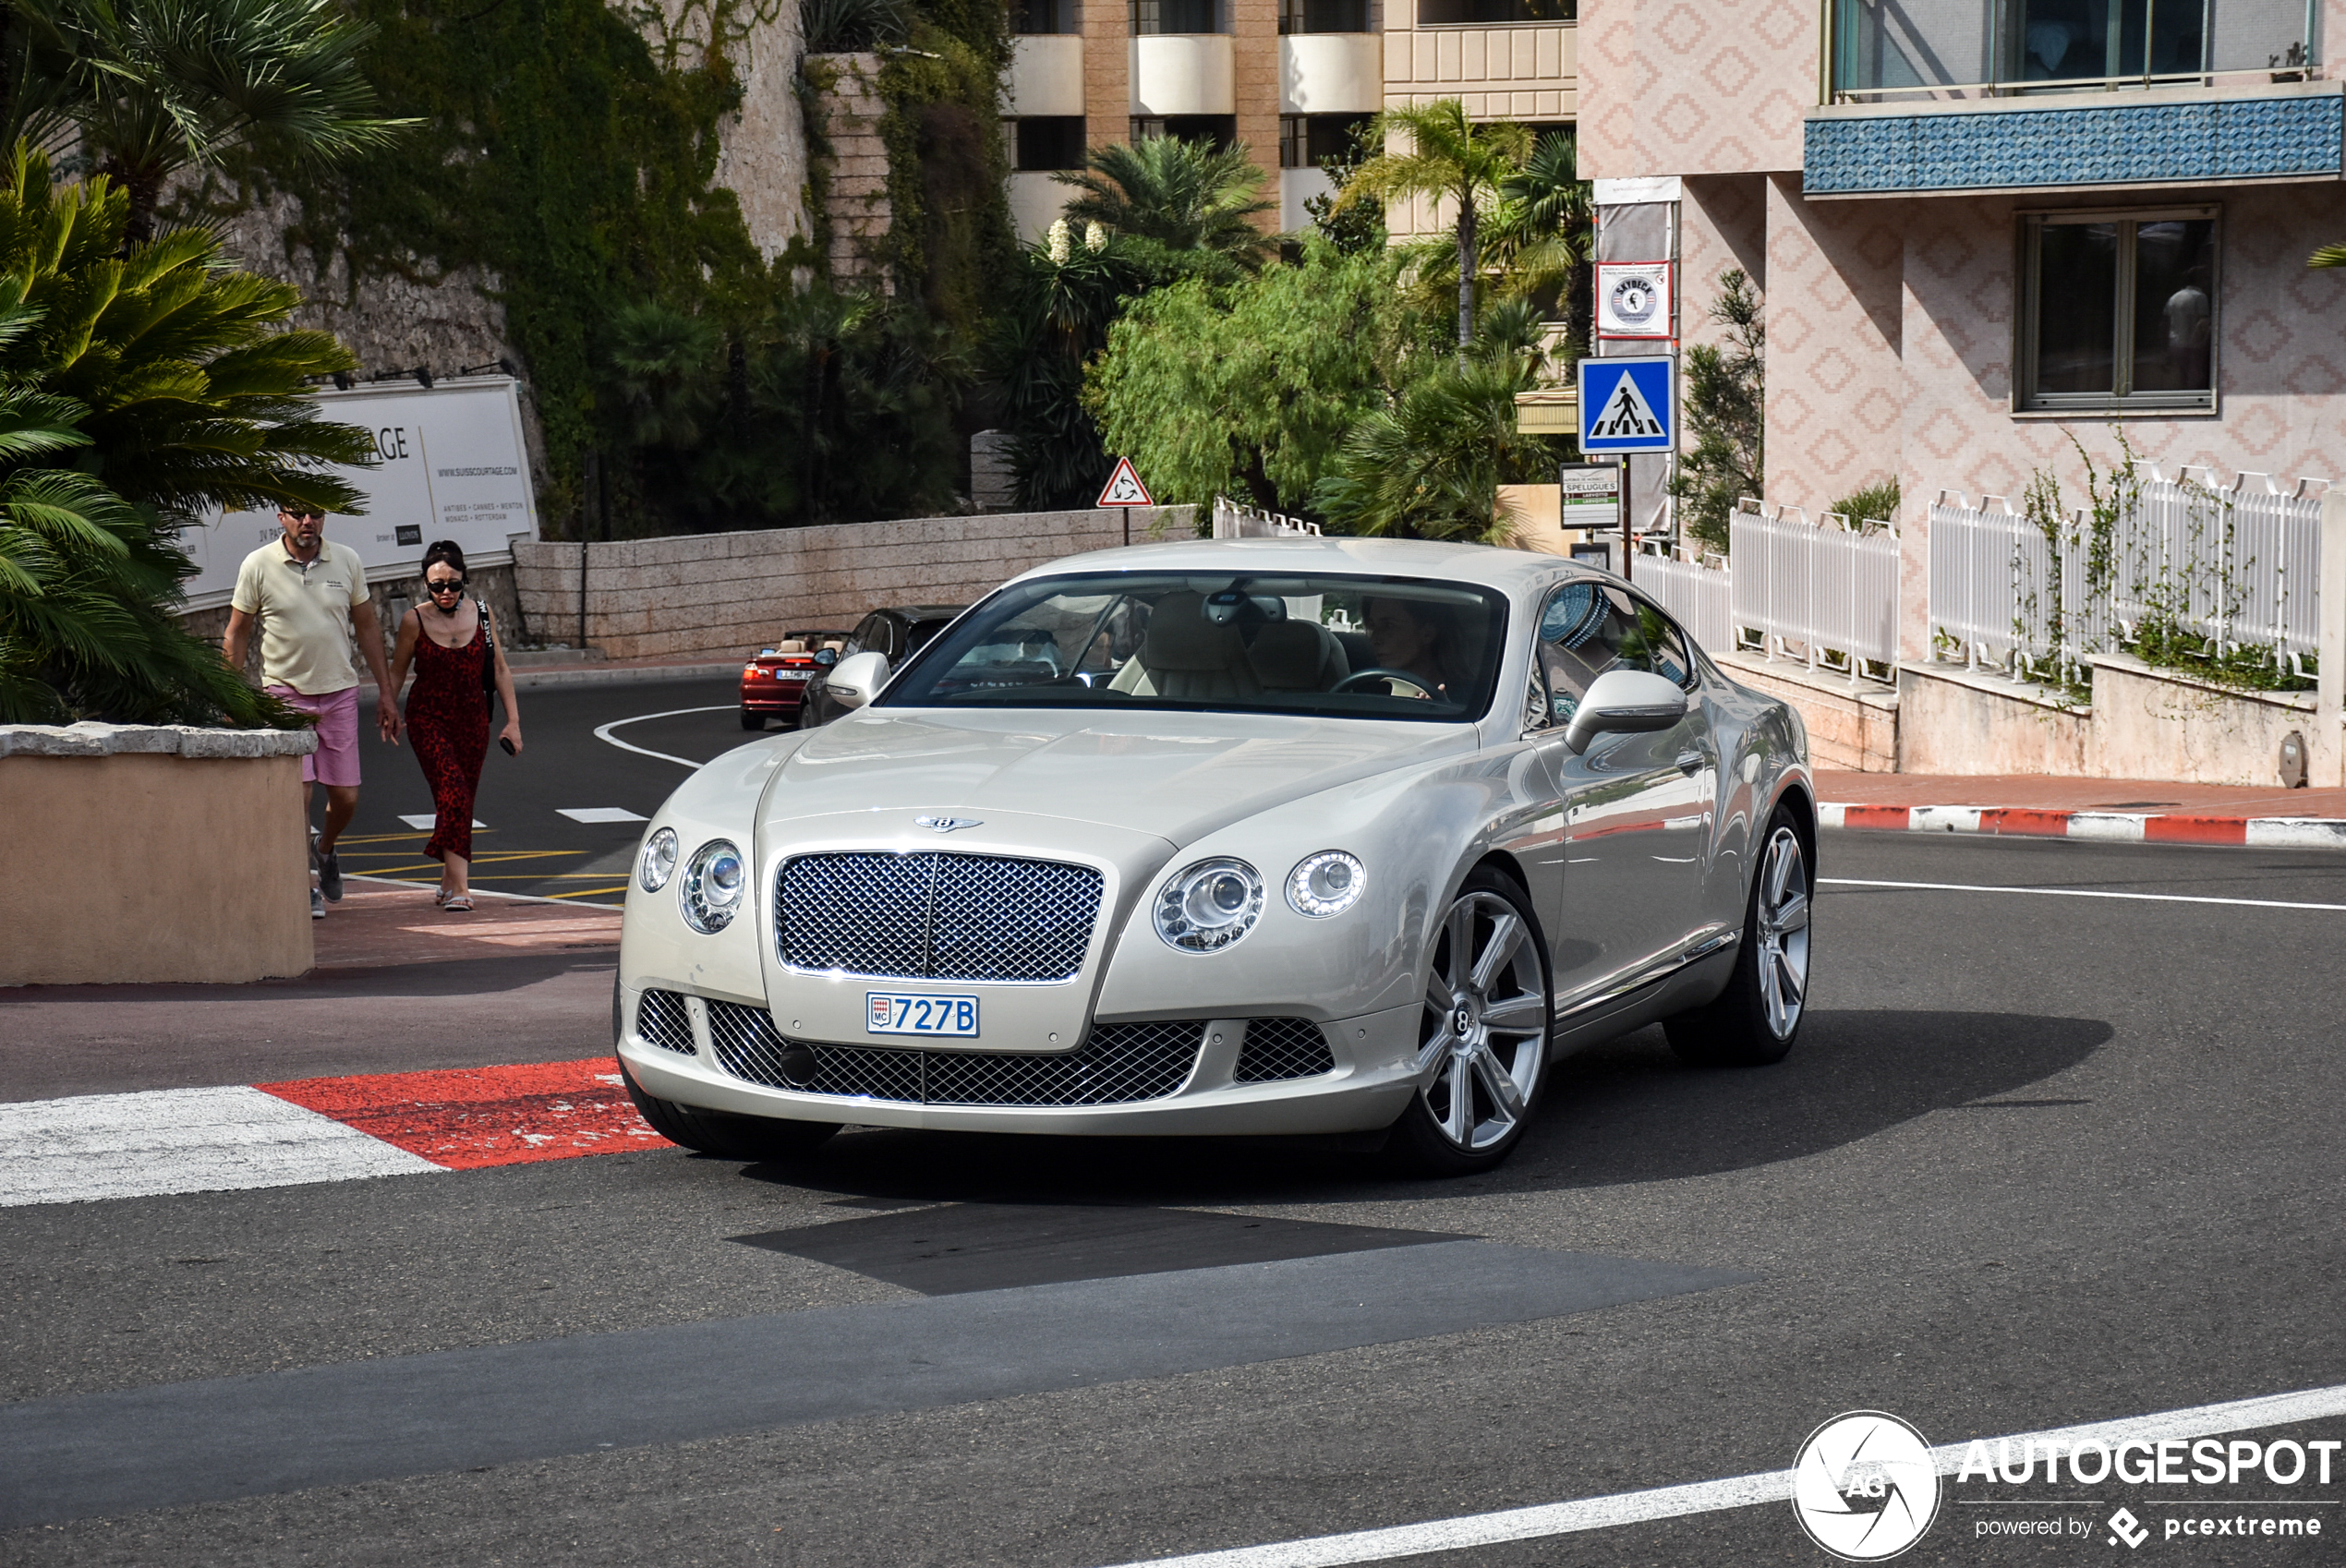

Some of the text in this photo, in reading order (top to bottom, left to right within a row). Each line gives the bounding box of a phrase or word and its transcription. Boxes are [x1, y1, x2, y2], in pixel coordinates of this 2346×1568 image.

[1616, 280, 1653, 296] SKYDECK
[437, 466, 518, 477] WWW.SUISSCOURTAGE.COM
[1566, 483, 1615, 491] SPELUGUES
[443, 501, 524, 513] ANTIBES CANNES MENTON
[444, 513, 508, 524] MONACO ROTTERDAM
[874, 998, 974, 1031] MC 727B
